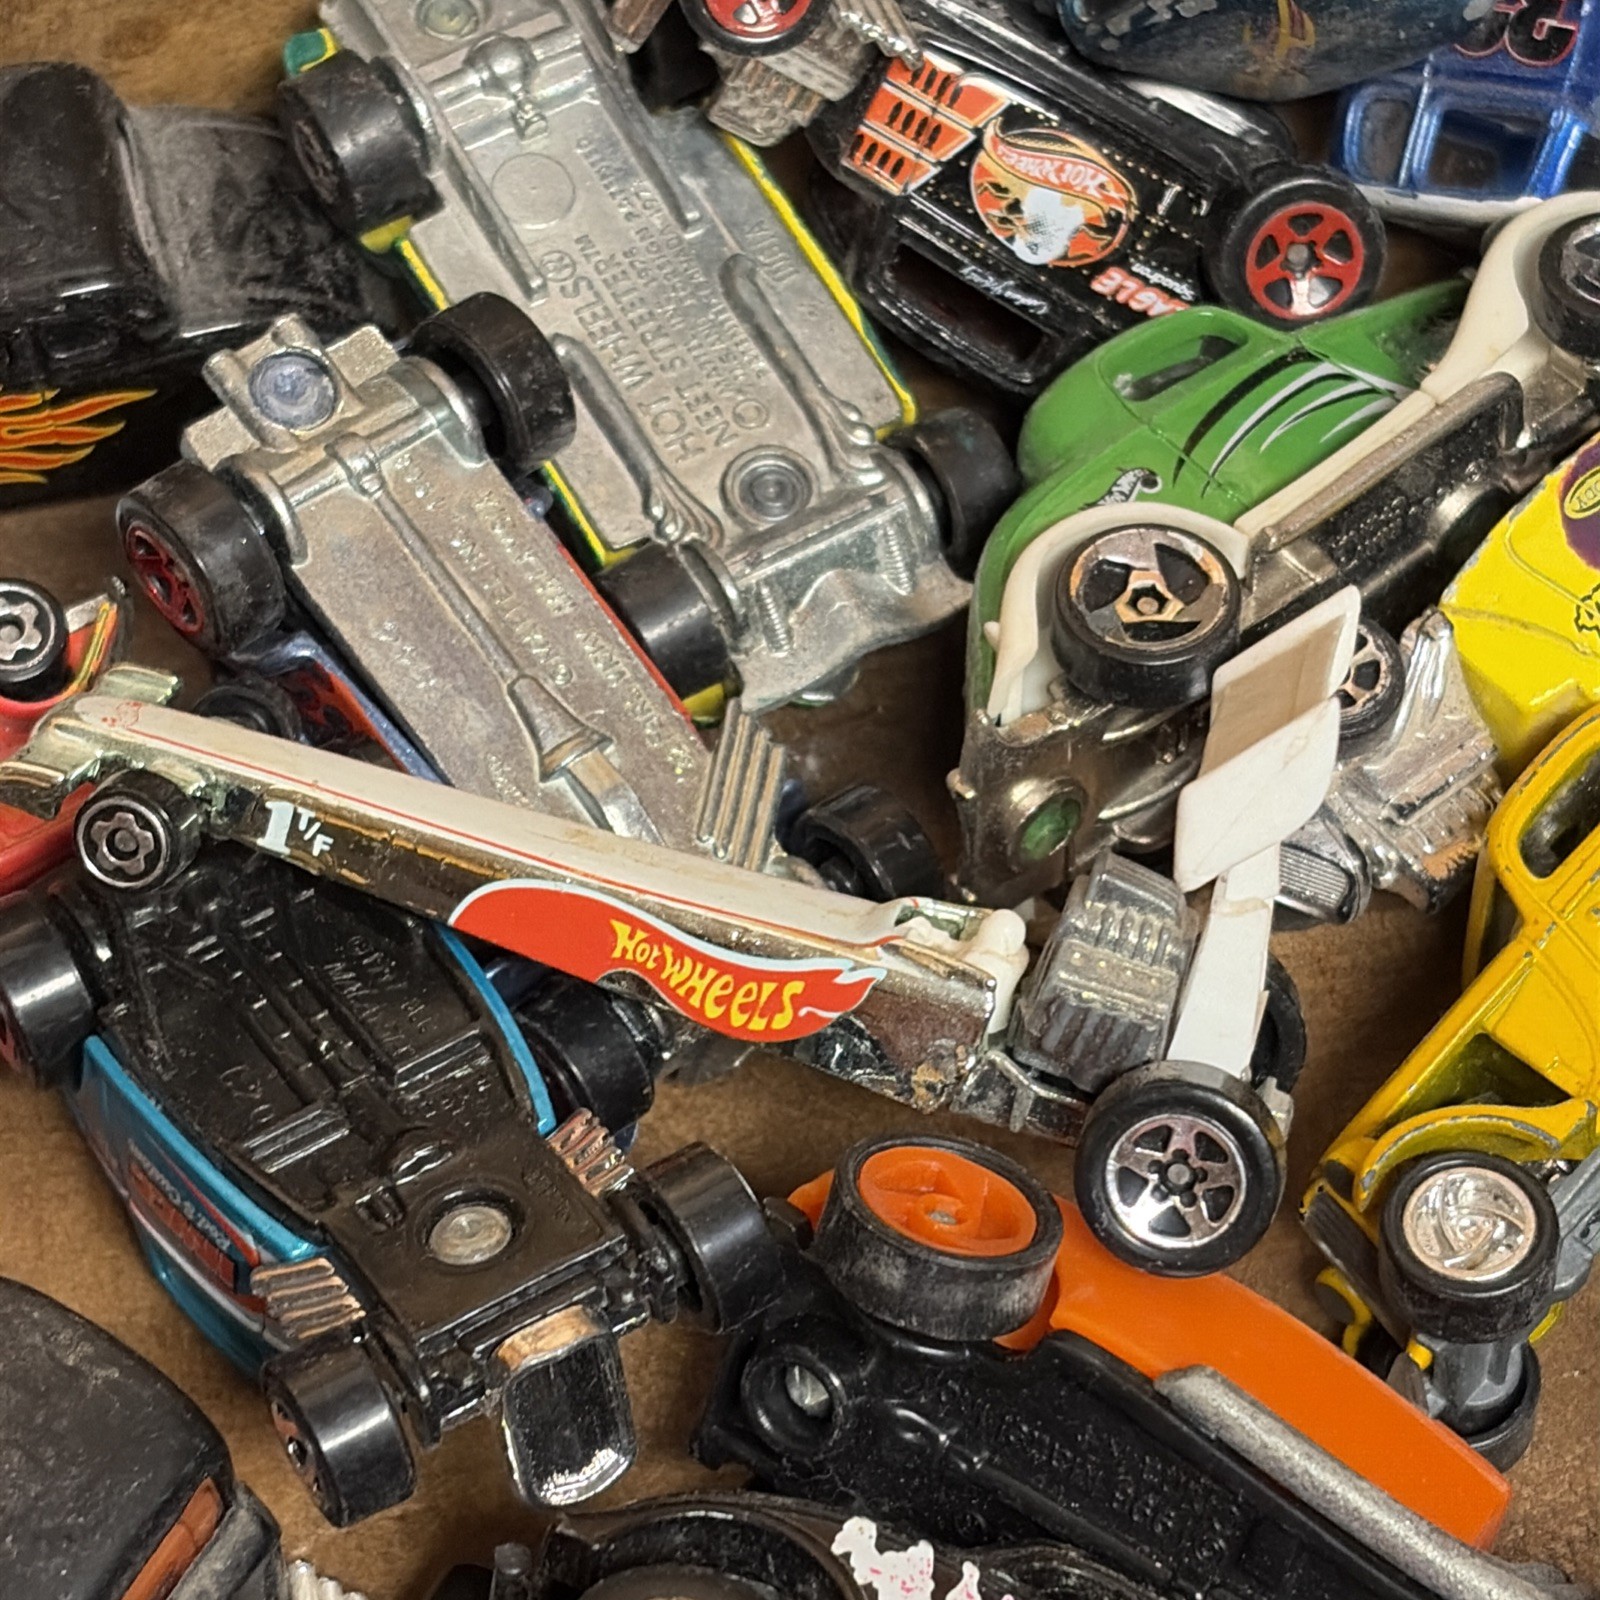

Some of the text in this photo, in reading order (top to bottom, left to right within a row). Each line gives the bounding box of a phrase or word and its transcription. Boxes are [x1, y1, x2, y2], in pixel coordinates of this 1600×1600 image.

[1130, 263, 1196, 302] Squadron
[637, 395, 702, 465] HOT
[681, 379, 739, 447] NEET
